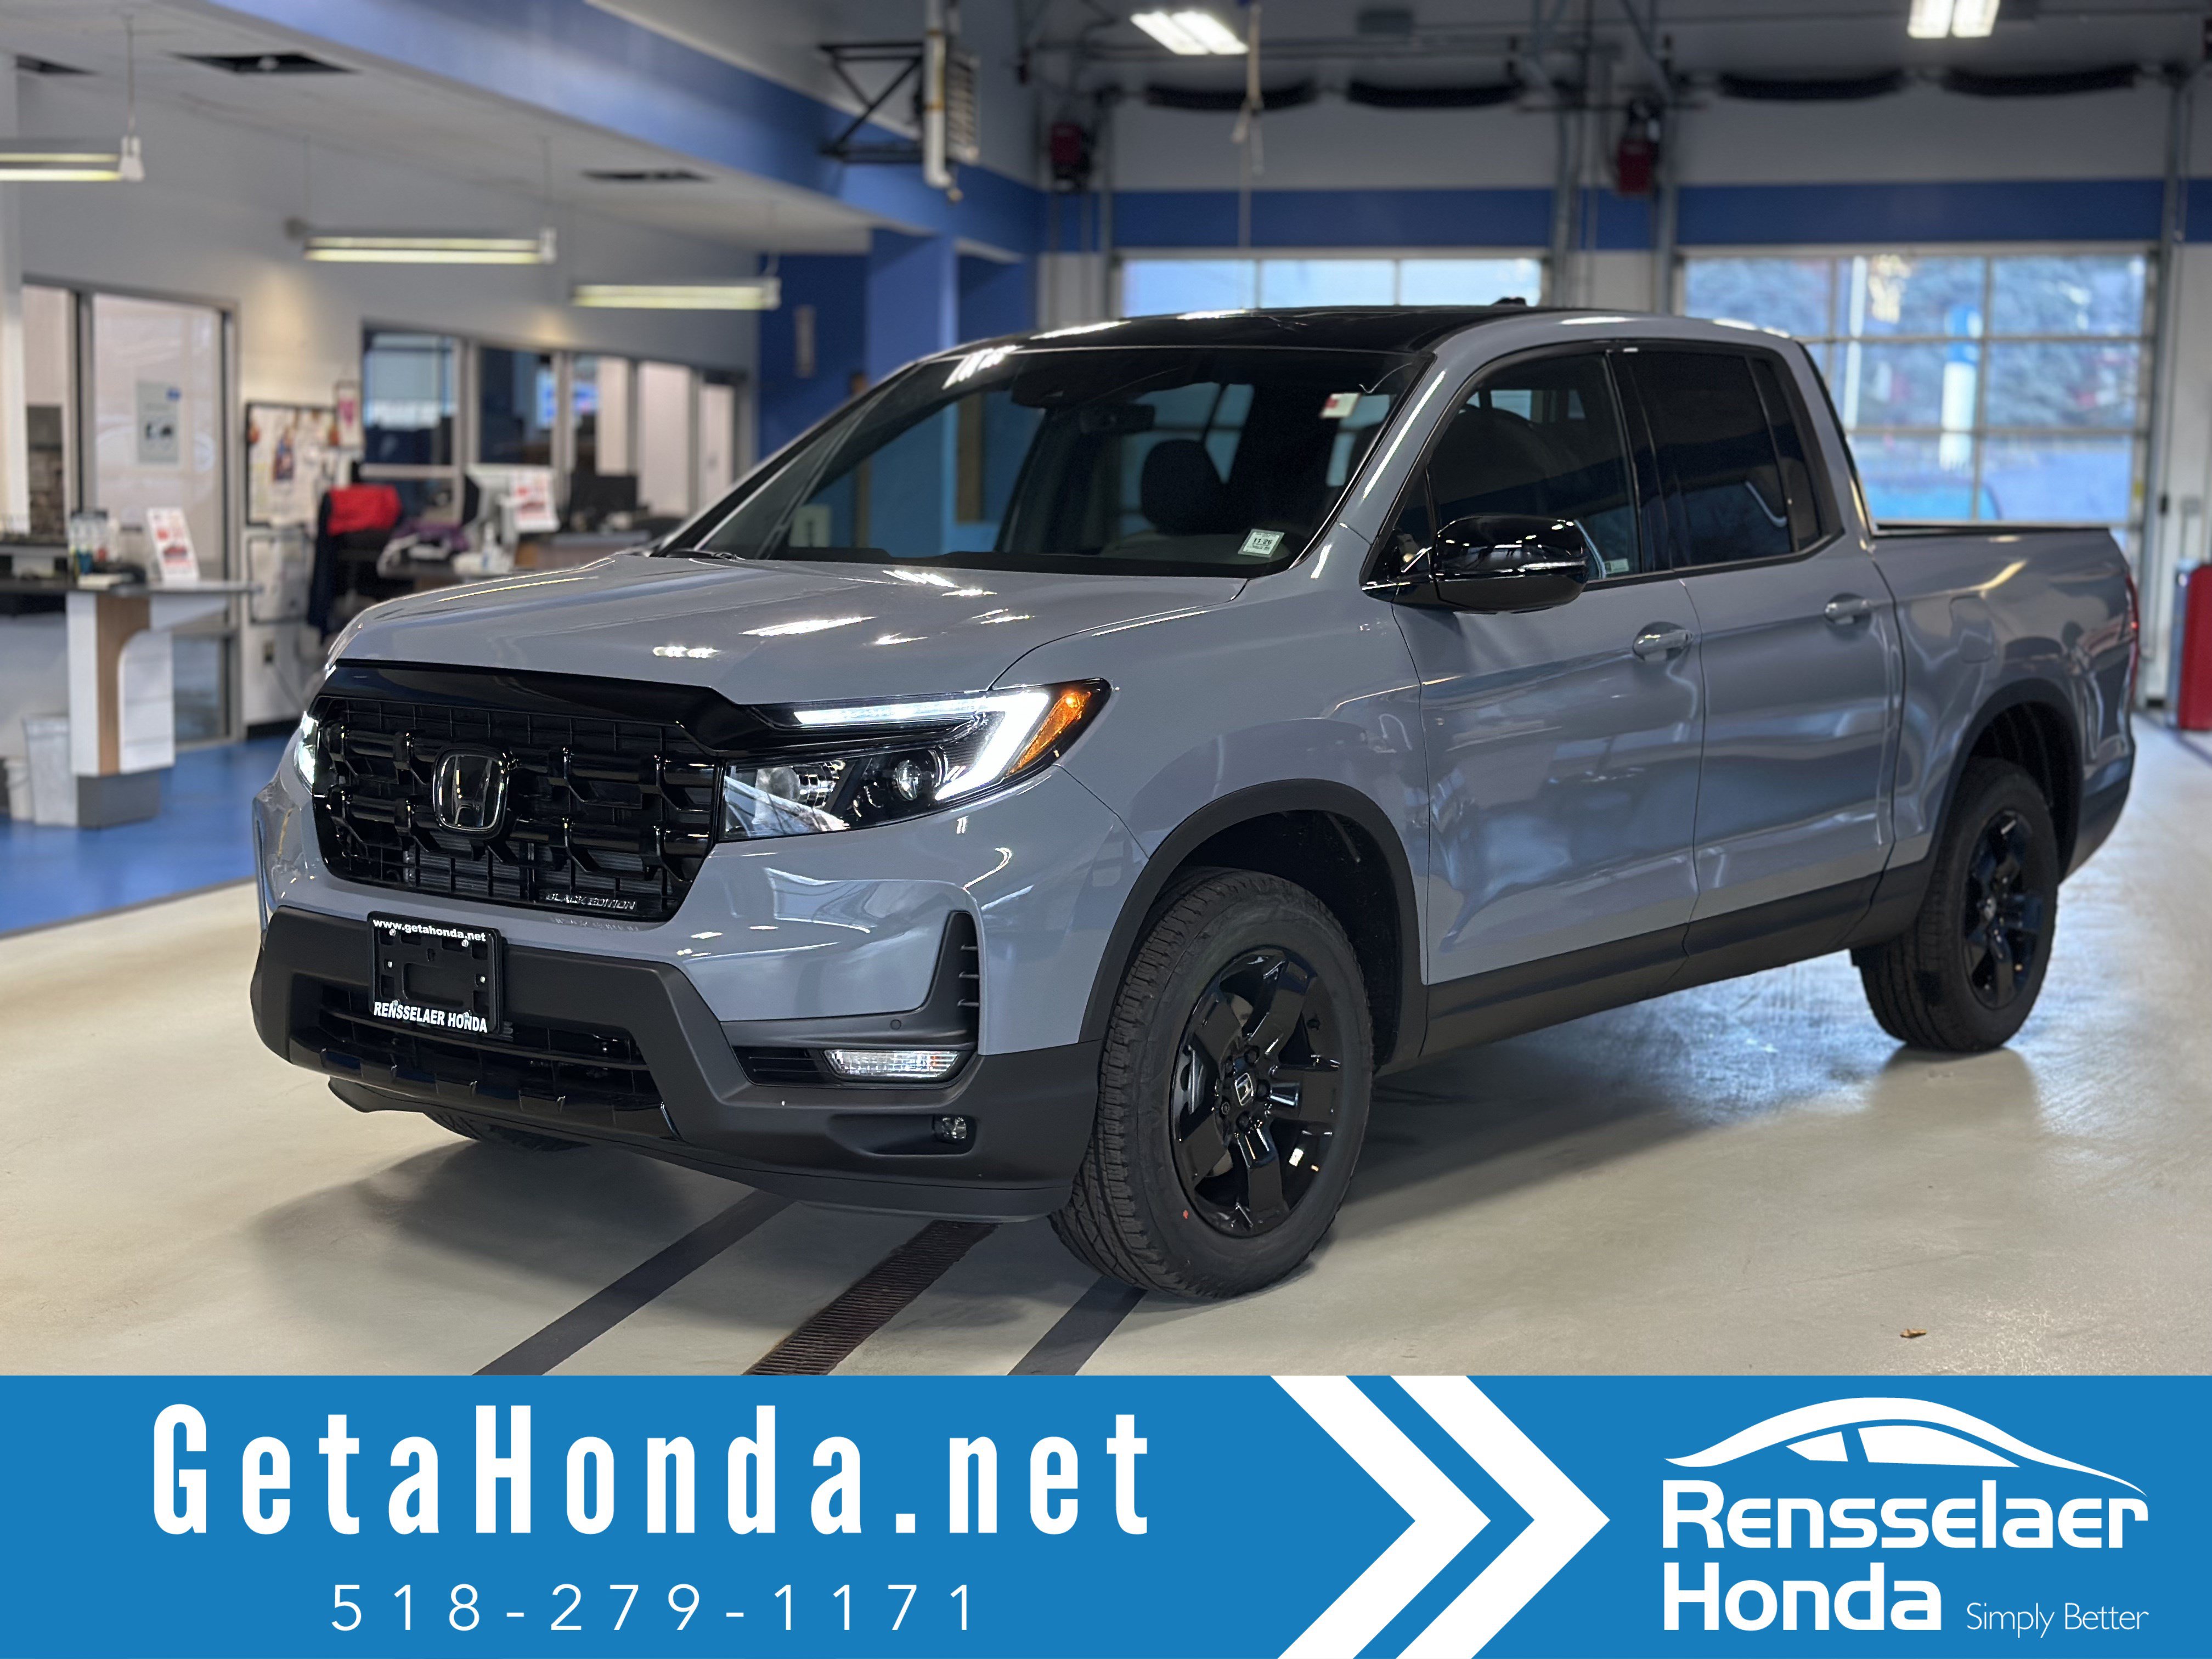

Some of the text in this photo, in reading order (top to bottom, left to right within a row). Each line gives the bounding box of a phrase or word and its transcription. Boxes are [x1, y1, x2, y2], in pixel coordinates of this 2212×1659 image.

[588, 897, 636, 910] EDITION
[373, 919, 487, 942] www.getahonda.net
[374, 1001, 488, 1033] RENSSELAER HONDA
